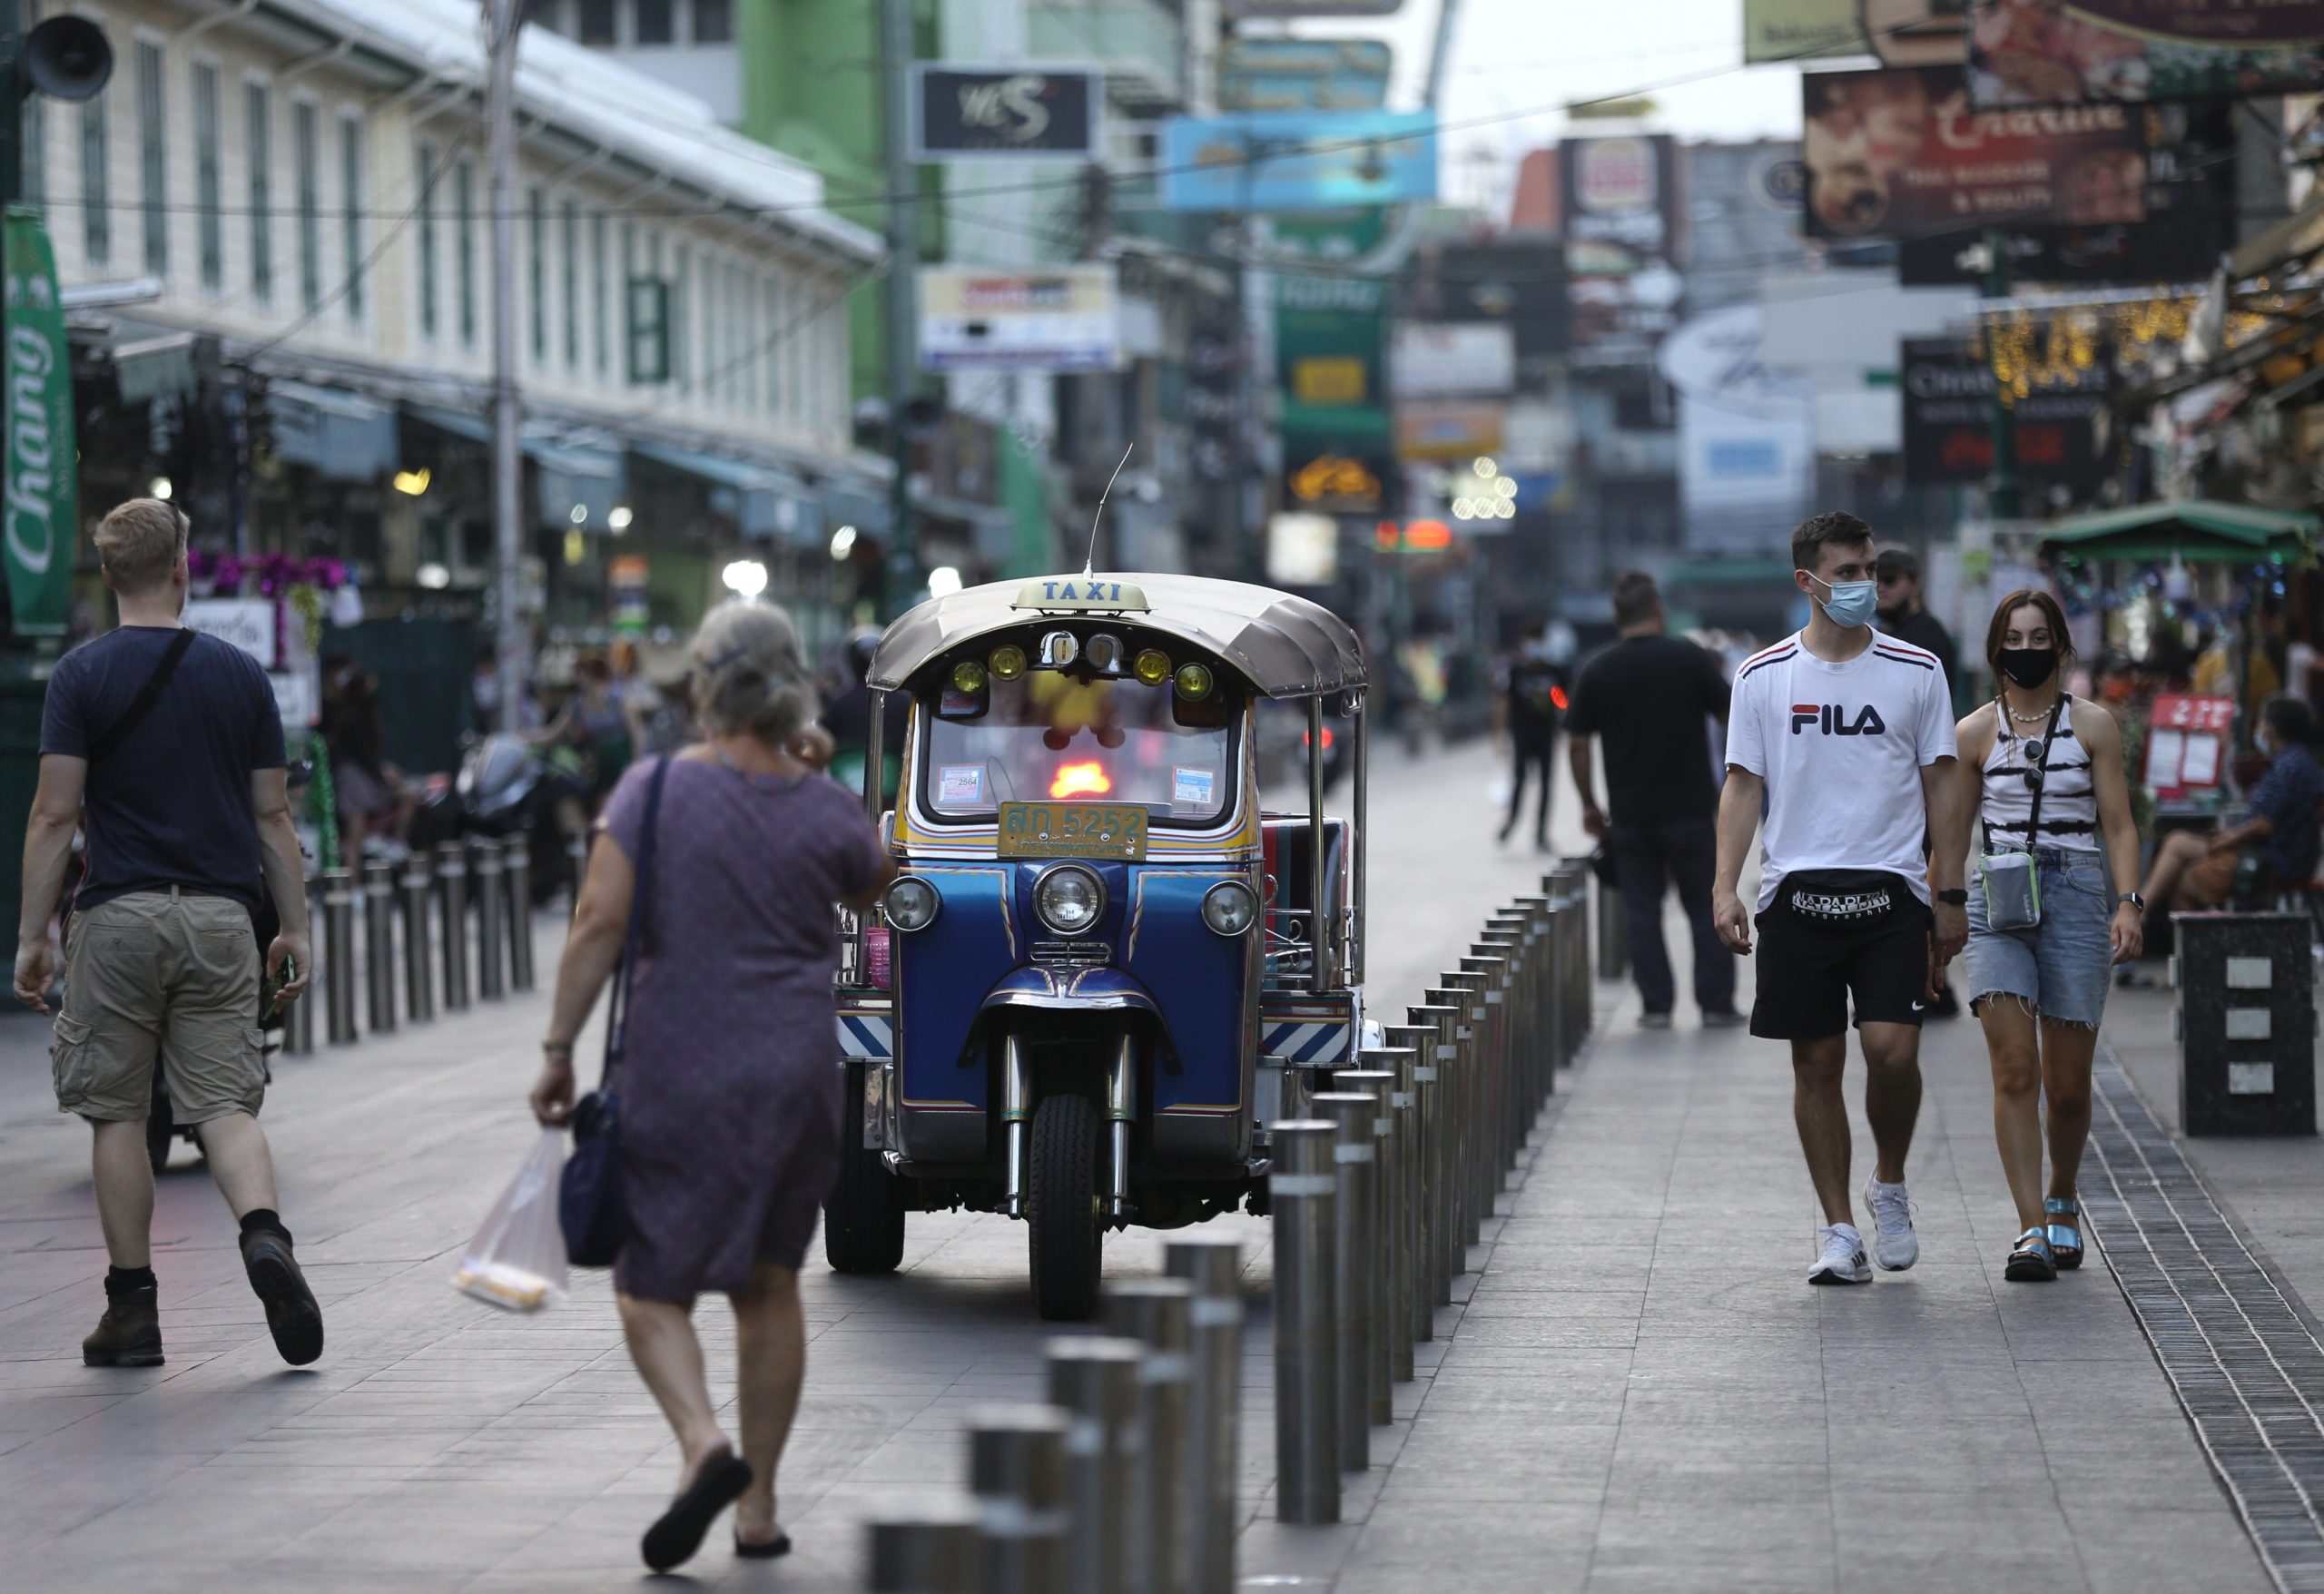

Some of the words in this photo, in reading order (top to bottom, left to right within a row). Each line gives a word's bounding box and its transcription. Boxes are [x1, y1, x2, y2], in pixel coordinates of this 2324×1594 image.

[6, 325, 54, 574] Chang
[1042, 582, 1121, 601] TAXI
[1792, 704, 1886, 735] FILA
[958, 778, 977, 786] 2564
[1064, 808, 1141, 838] 5252
